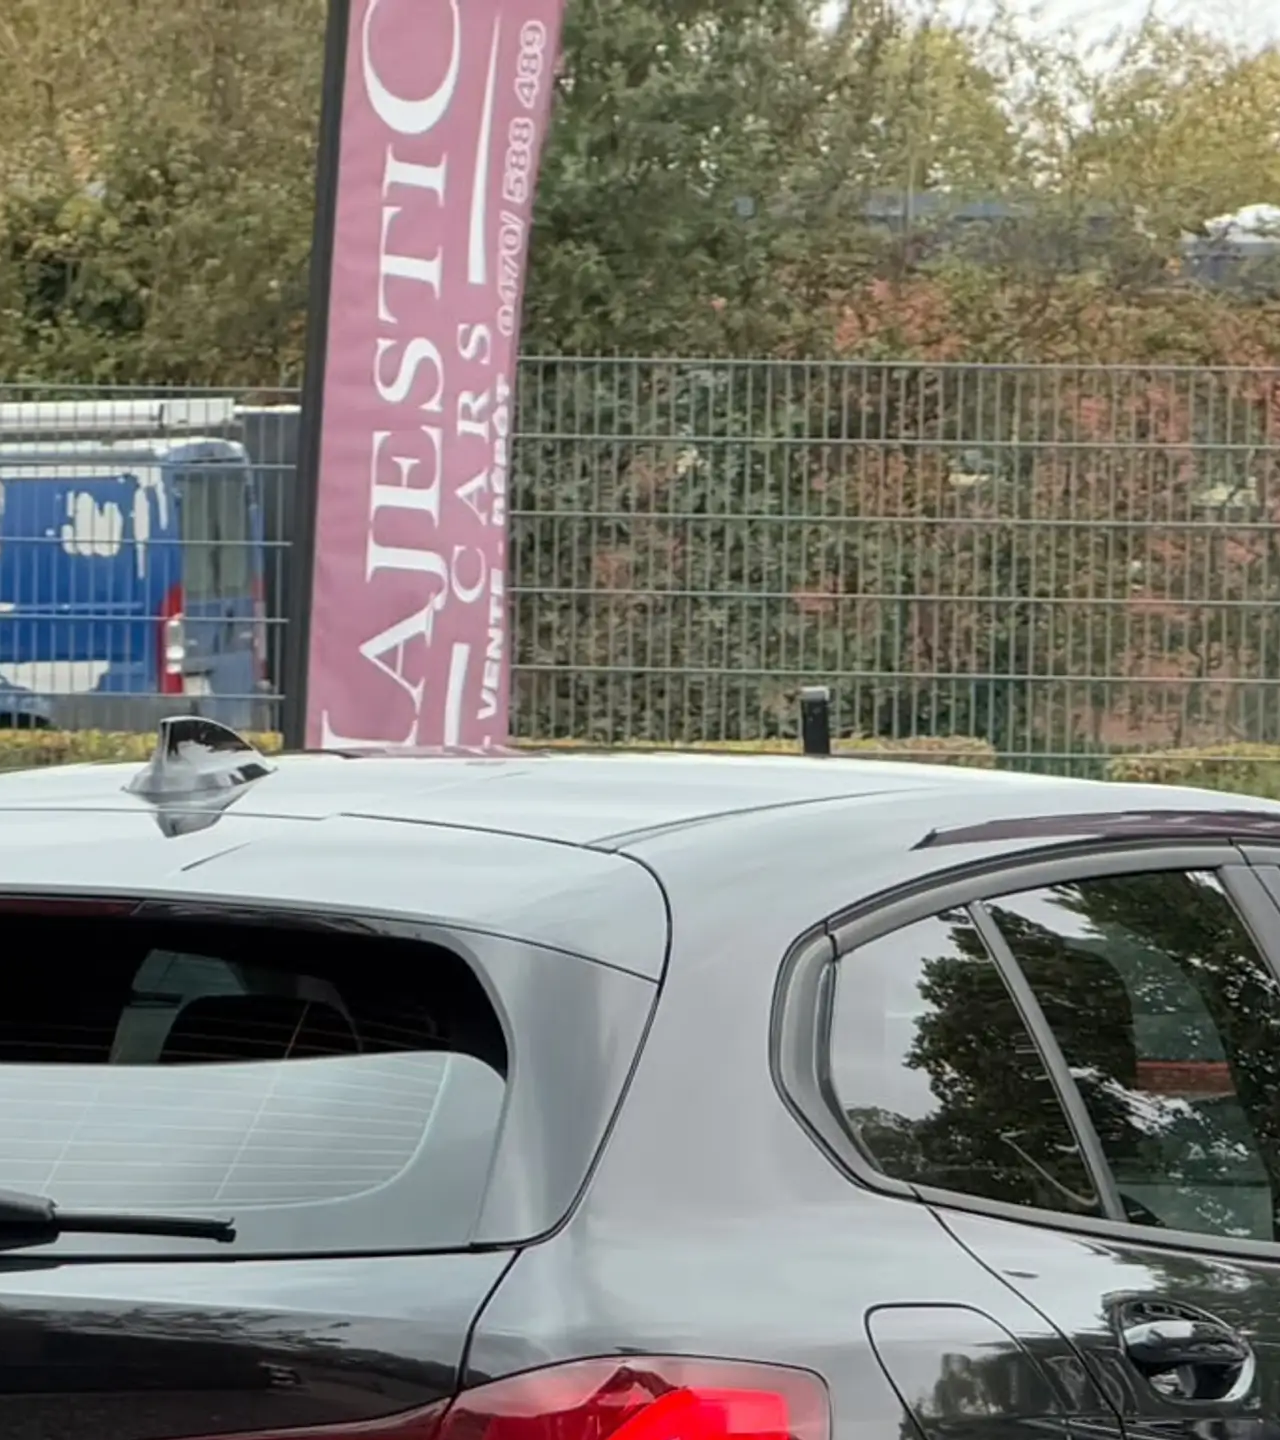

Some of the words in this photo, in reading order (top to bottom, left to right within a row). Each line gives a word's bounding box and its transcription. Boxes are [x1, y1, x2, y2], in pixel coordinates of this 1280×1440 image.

[515, 20, 547, 109] 489
[502, 117, 535, 204] 588
[452, 322, 491, 603] CARS
[476, 567, 504, 720] VENTE
